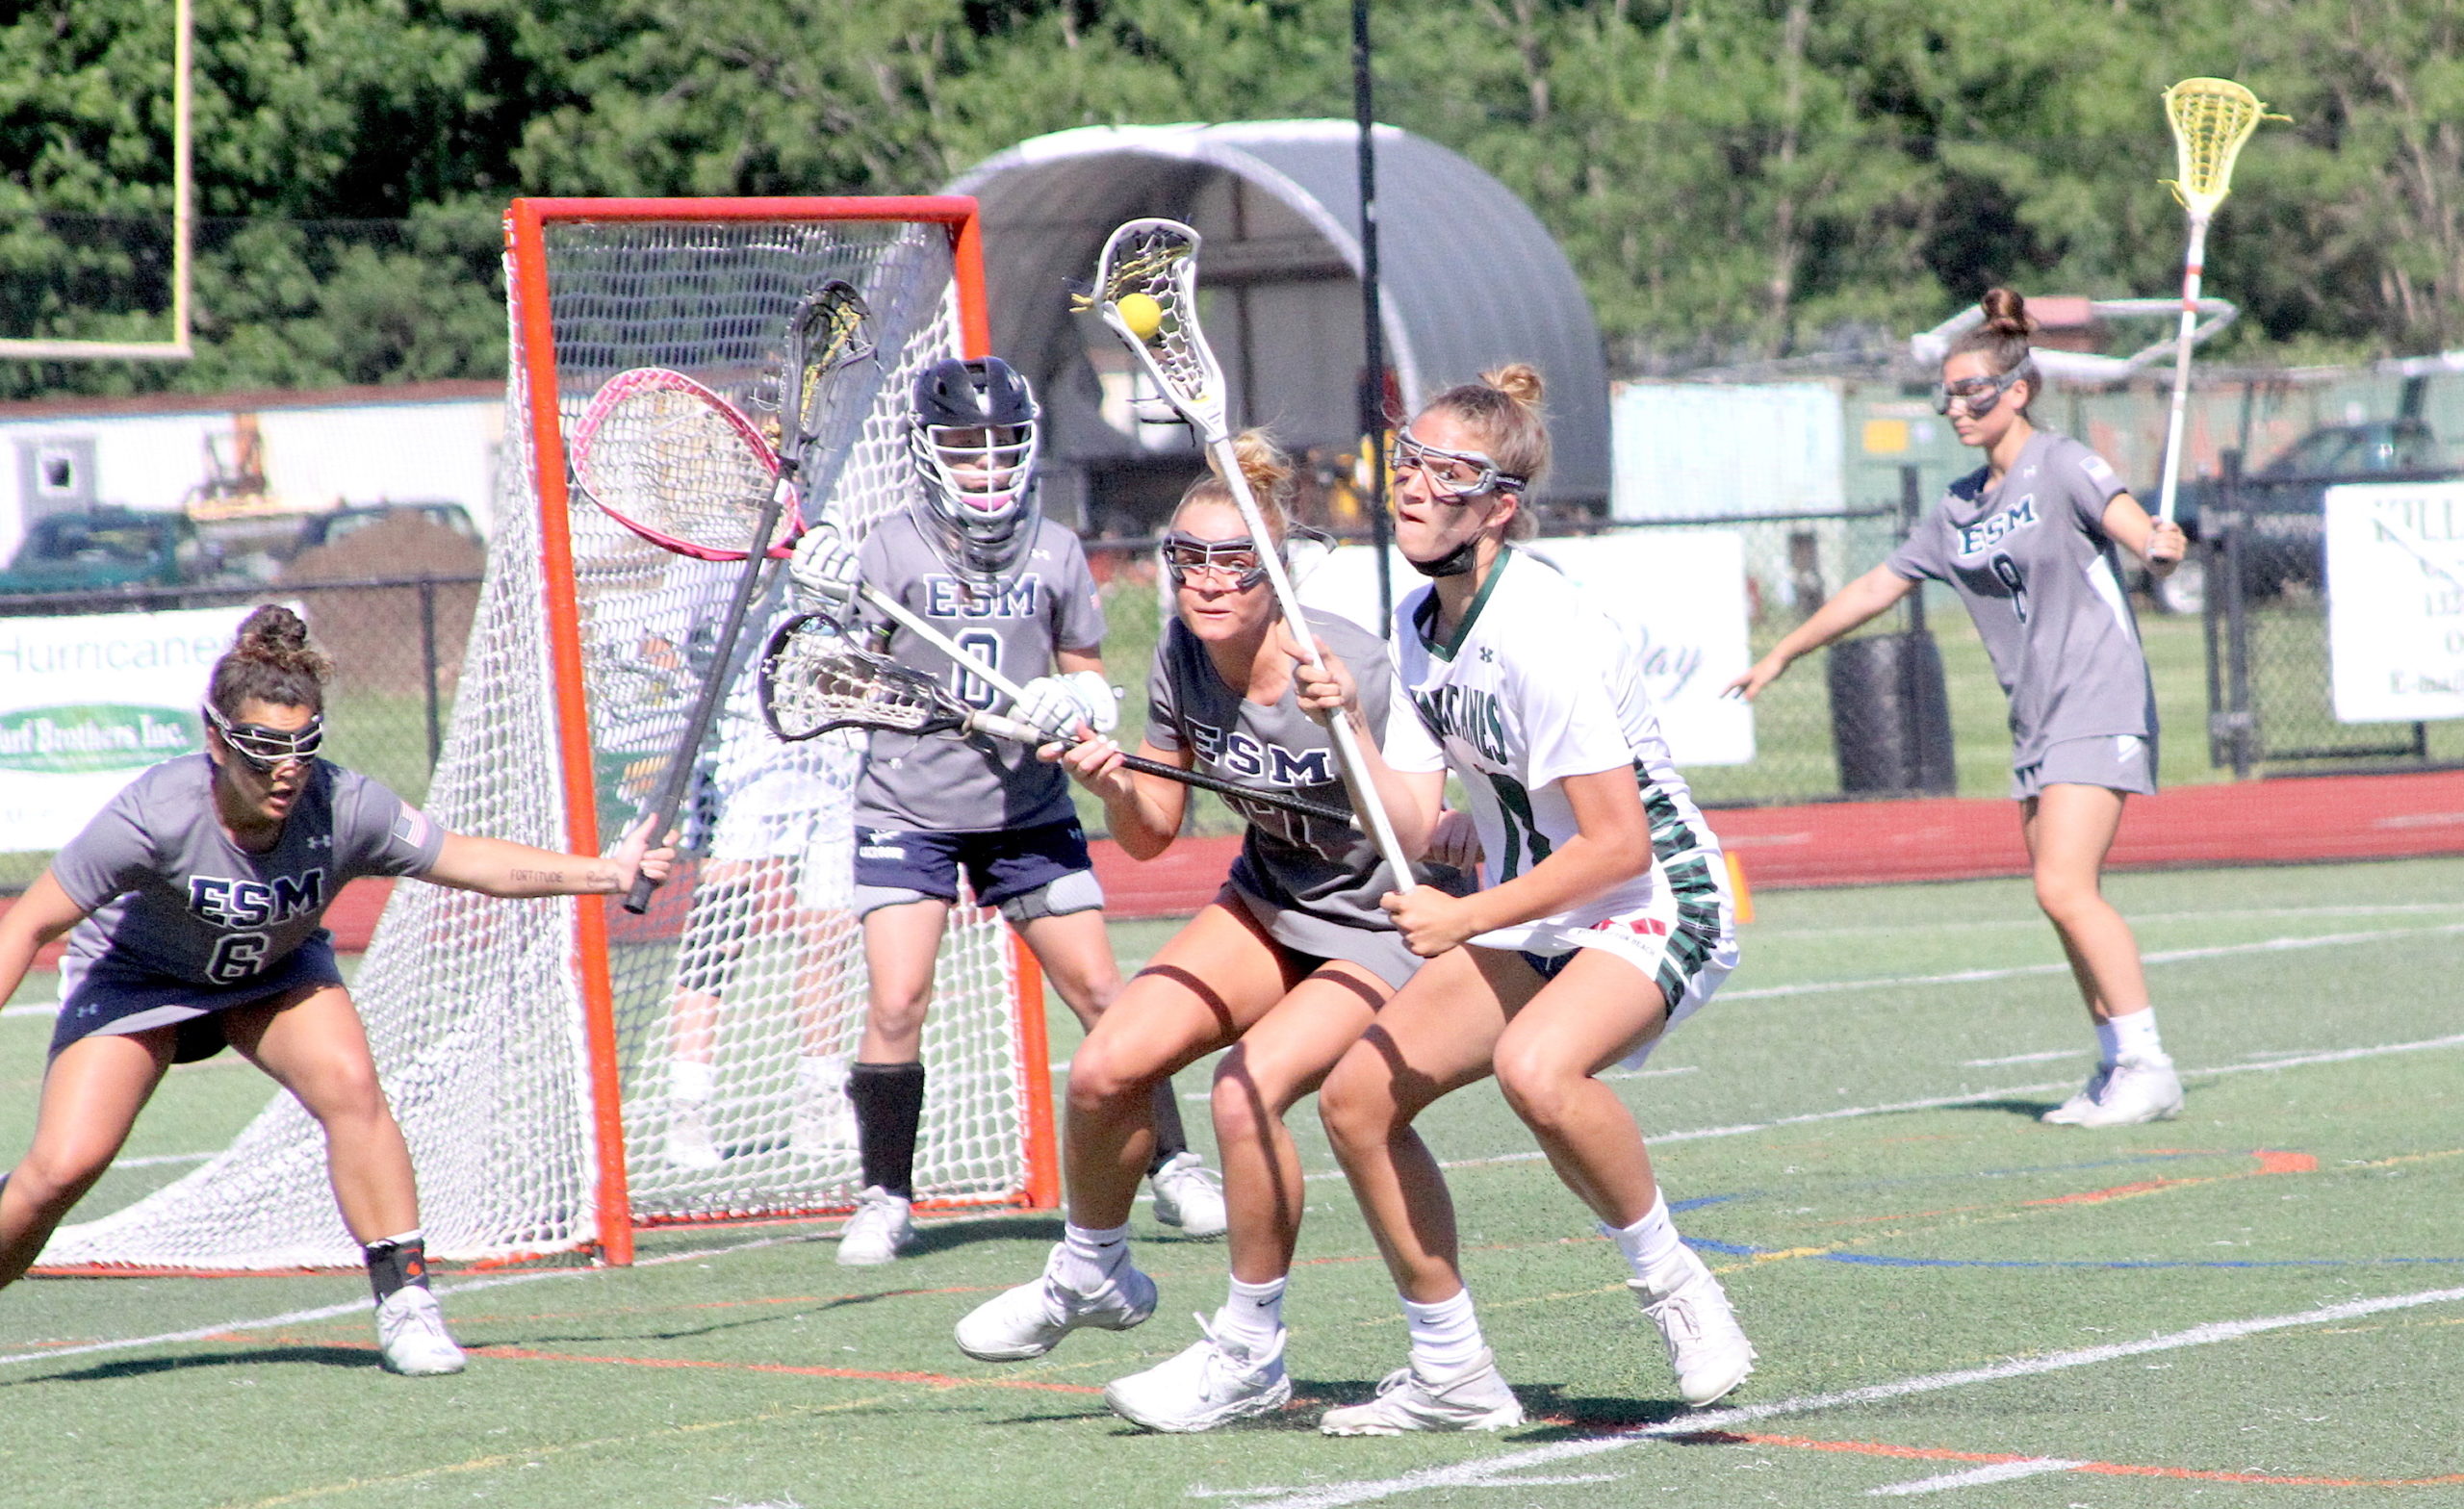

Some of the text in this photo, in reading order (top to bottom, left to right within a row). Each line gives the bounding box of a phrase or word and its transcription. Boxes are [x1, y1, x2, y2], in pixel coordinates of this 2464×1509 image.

[1957, 493, 2040, 556] ESM
[923, 573, 1041, 621] ESM
[0, 633, 234, 674] Hurricane
[951, 627, 1002, 715] 0
[1184, 715, 1337, 786] ESM
[187, 867, 324, 930] ESM
[510, 868, 564, 883] FORTITUDE
[205, 932, 270, 985] 6
